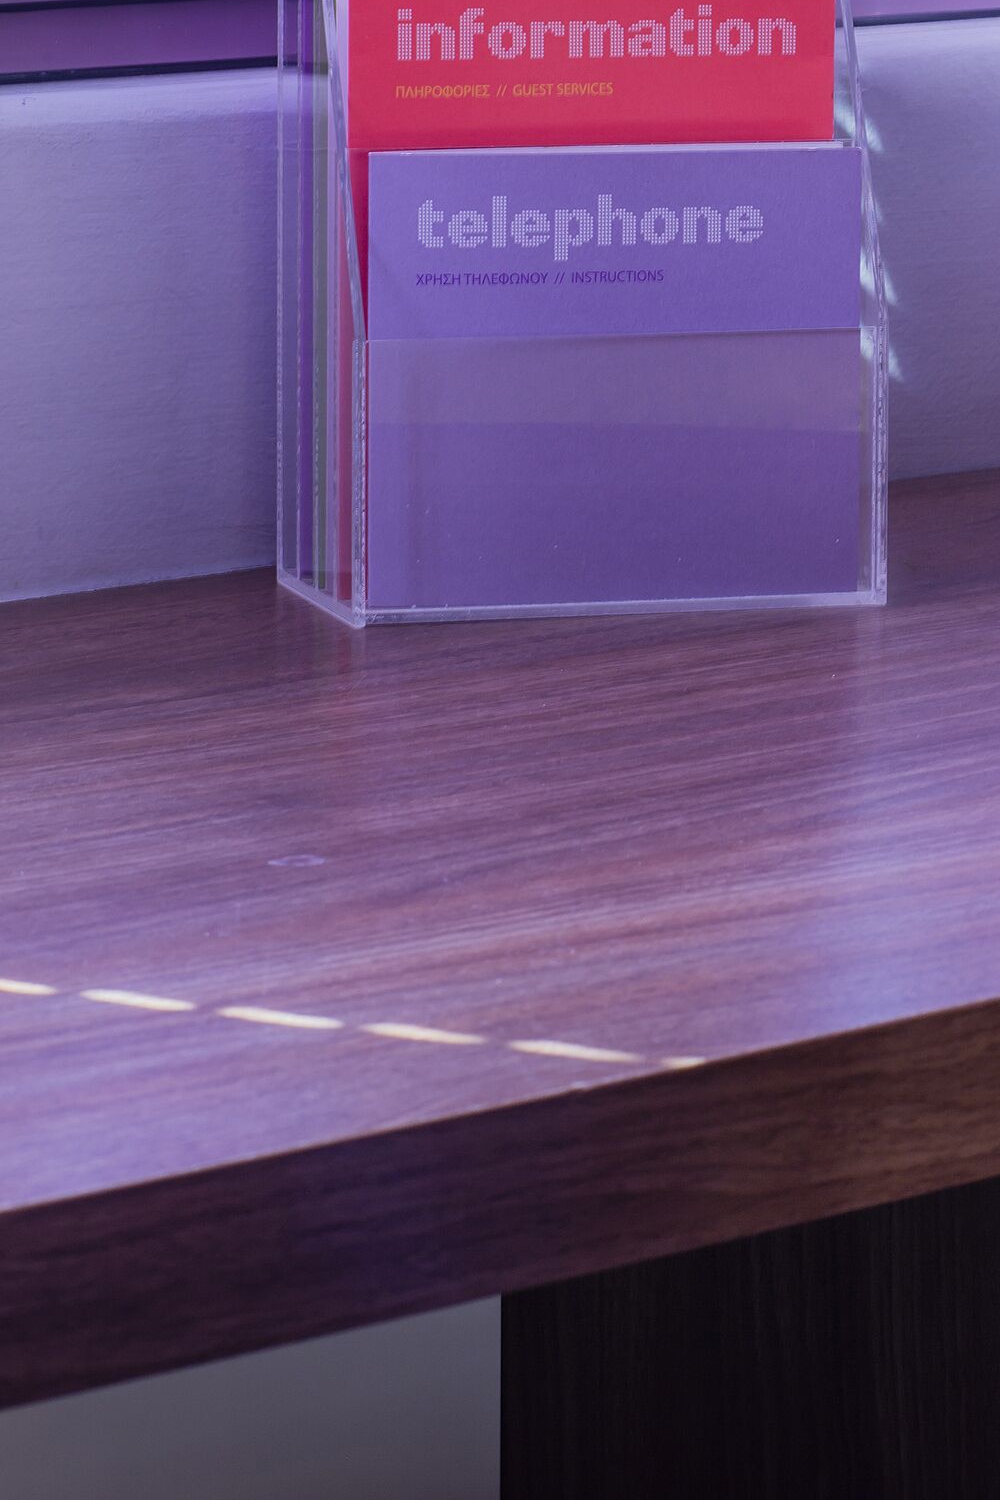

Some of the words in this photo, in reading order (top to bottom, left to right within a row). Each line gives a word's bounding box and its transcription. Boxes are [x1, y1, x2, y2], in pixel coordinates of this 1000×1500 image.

[396, 3, 797, 61] information
[395, 84, 490, 98] ΠΛΗΡΟΦΟΡΙΕΣ
[512, 83, 554, 97] GUEST
[556, 82, 614, 96] SERVICES
[417, 193, 764, 261] telephone
[415, 273, 461, 286] ΧΡΗΣΗ
[463, 272, 549, 285] ΤΗΛΕΦΩΝΟΥ
[571, 269, 664, 283] INSTRUCTIONS
